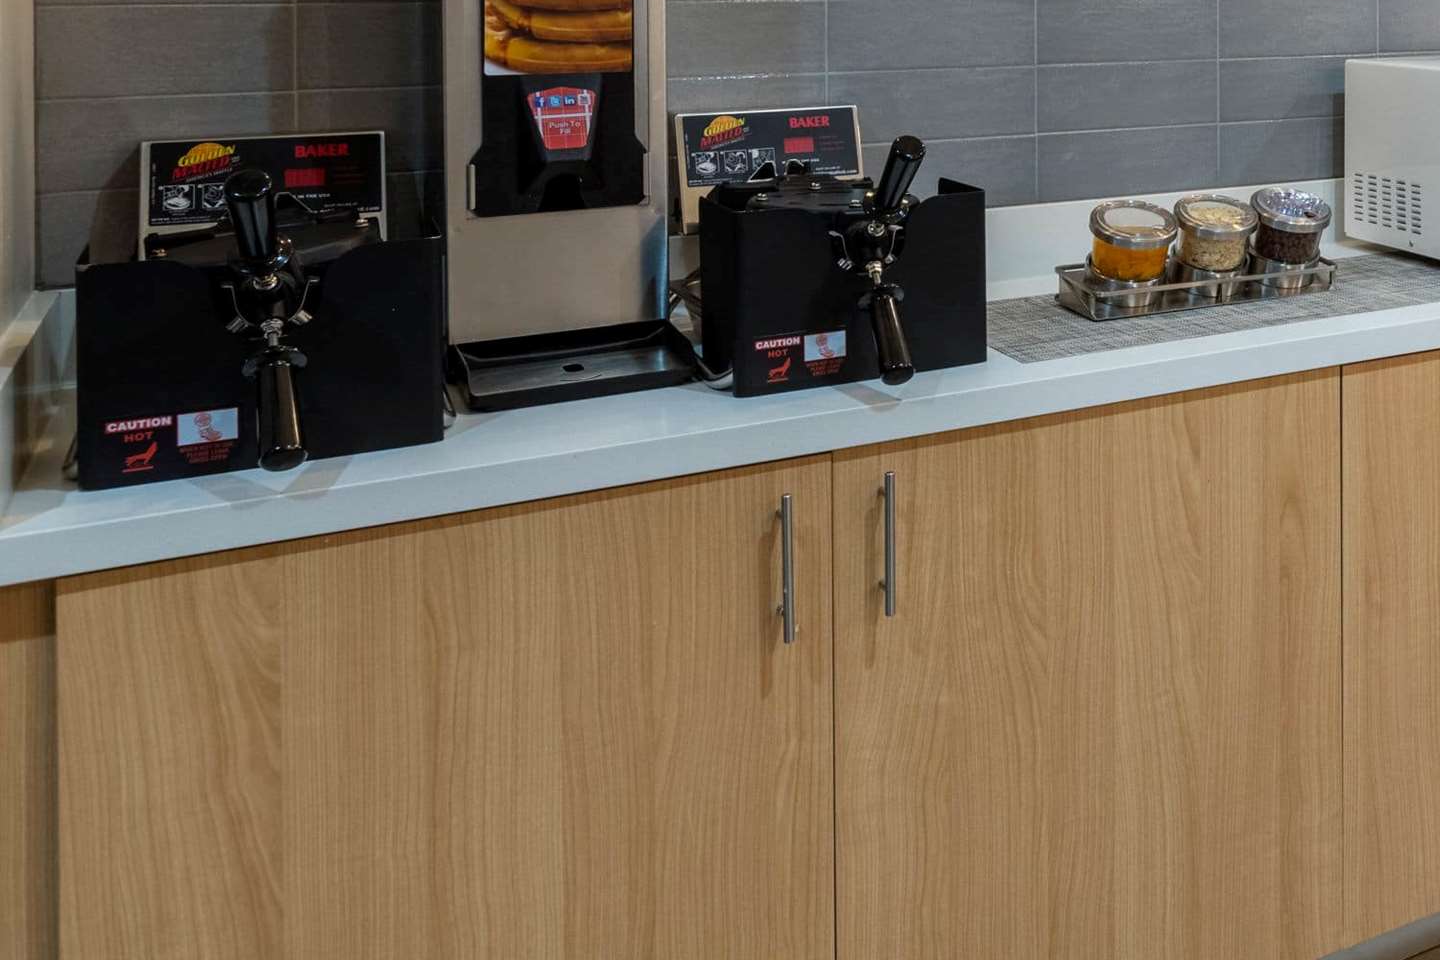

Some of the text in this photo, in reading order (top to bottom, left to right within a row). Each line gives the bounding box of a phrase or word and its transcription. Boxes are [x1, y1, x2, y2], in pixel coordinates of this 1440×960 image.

[788, 115, 830, 128] BAKER
[177, 144, 237, 167] GOLDEN
[294, 143, 350, 158] BAKER
[756, 337, 800, 350] CAUTION
[767, 348, 788, 359] HOT
[106, 416, 172, 433] CAUTION
[123, 431, 153, 443] HOT
